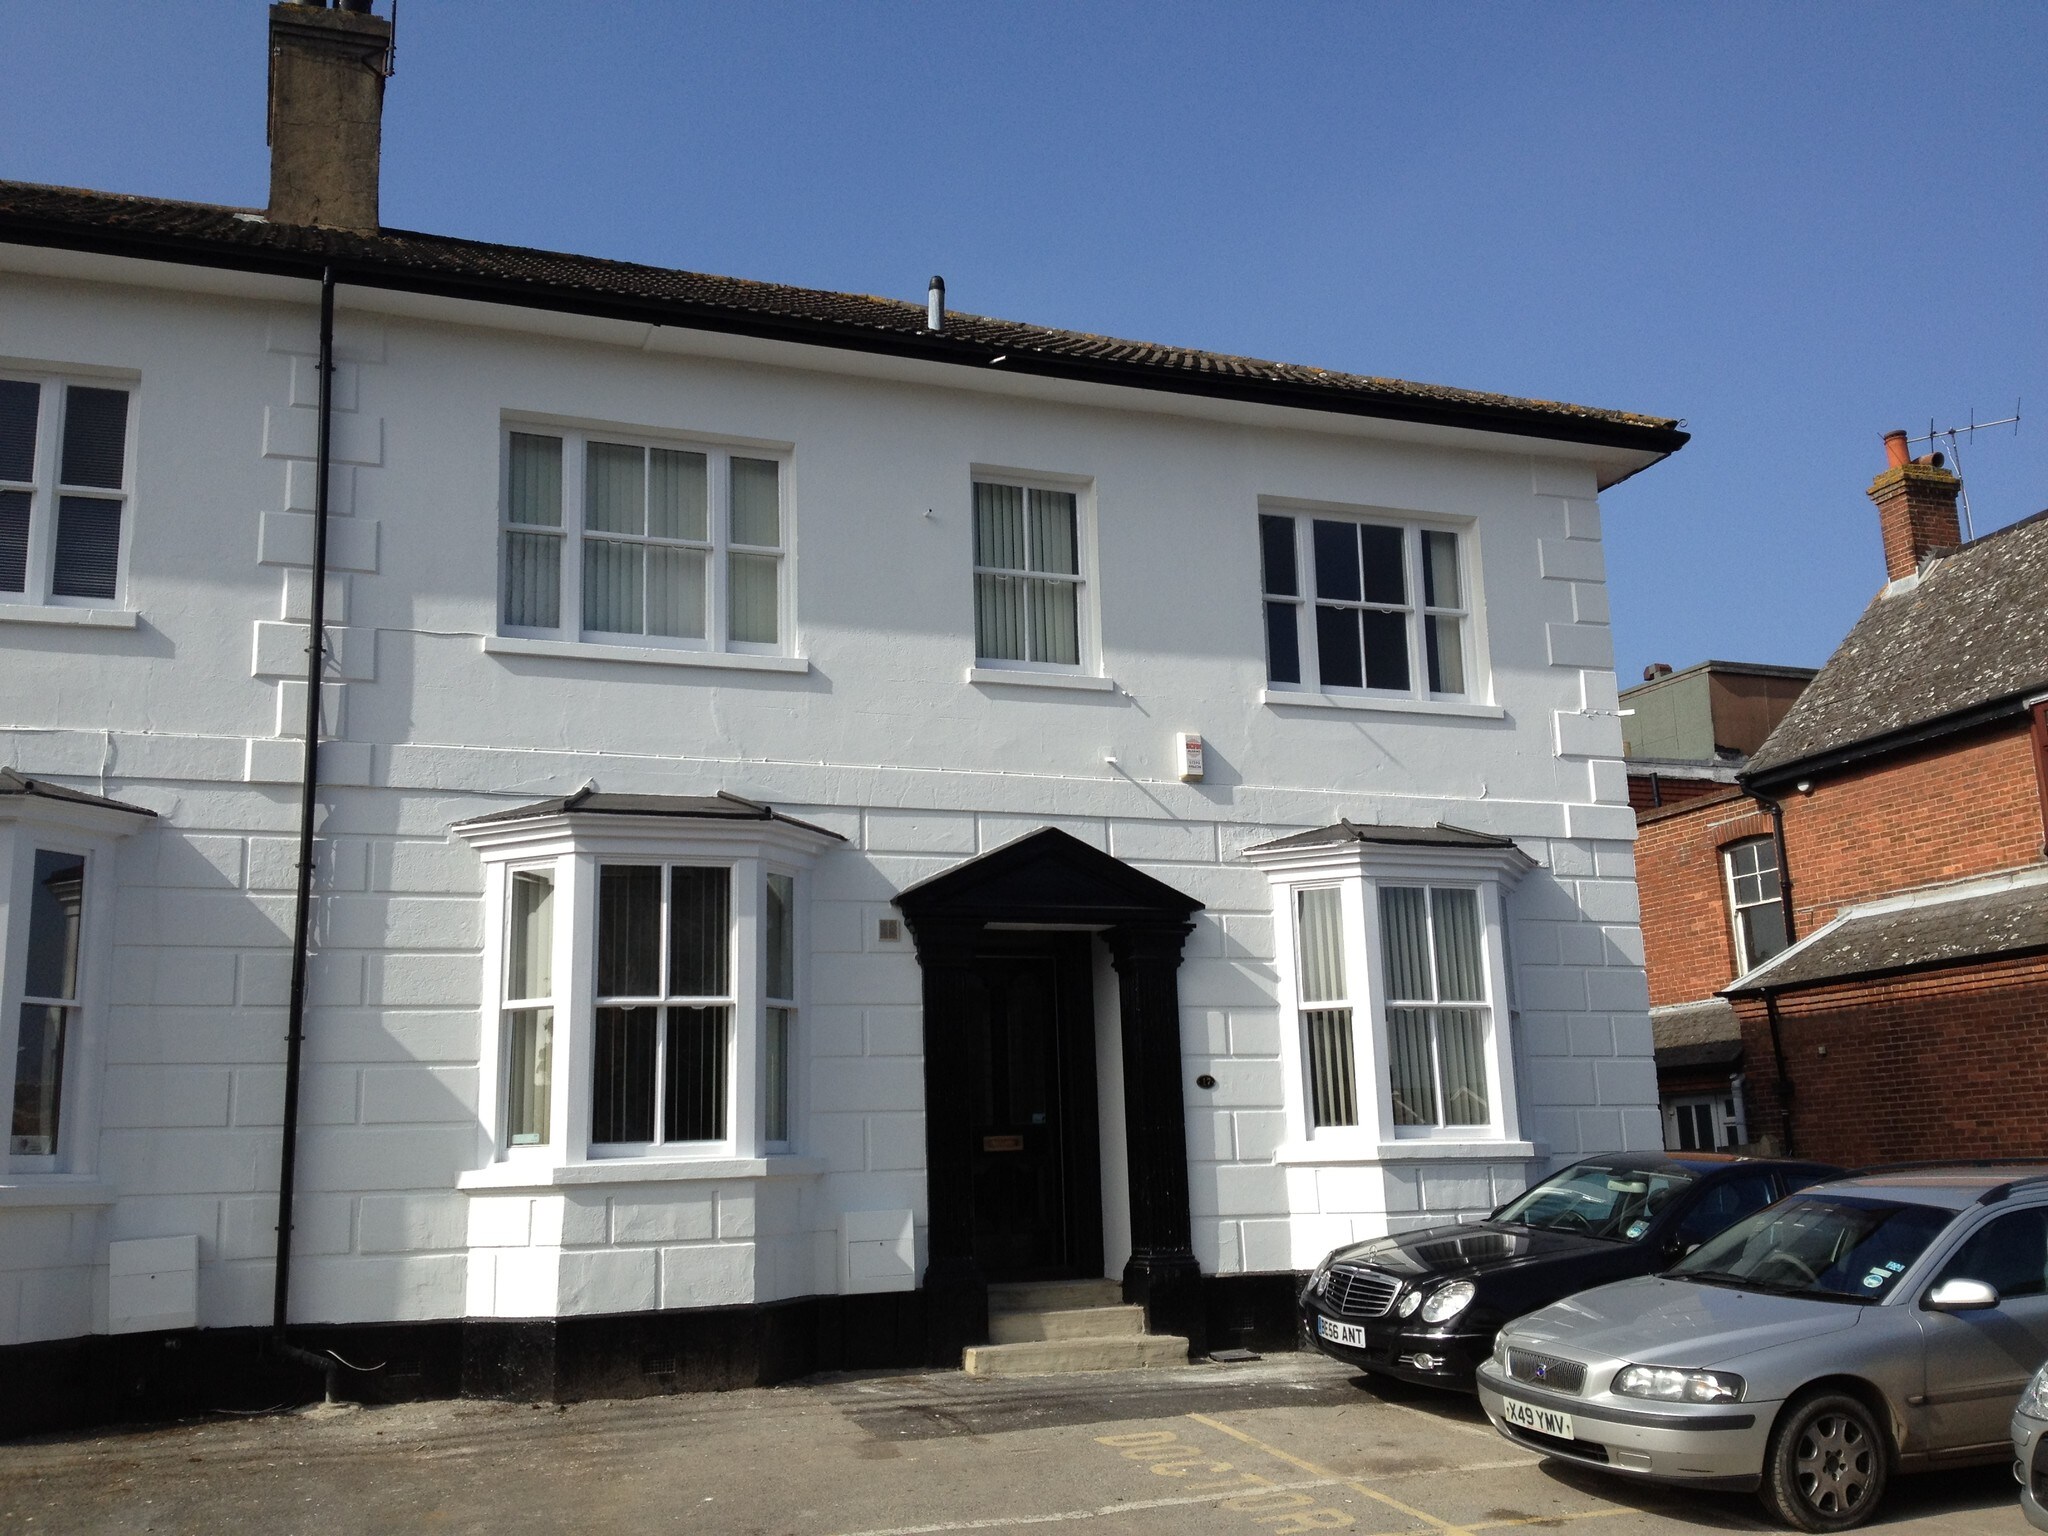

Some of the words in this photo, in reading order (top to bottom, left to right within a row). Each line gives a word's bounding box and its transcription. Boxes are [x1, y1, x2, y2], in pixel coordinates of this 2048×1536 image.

[1342, 1326, 1362, 1344] ANT
[1508, 1401, 1535, 1426] X49
[1535, 1410, 1564, 1434] YMV
[1094, 1431, 1356, 1535] DOCTOR
